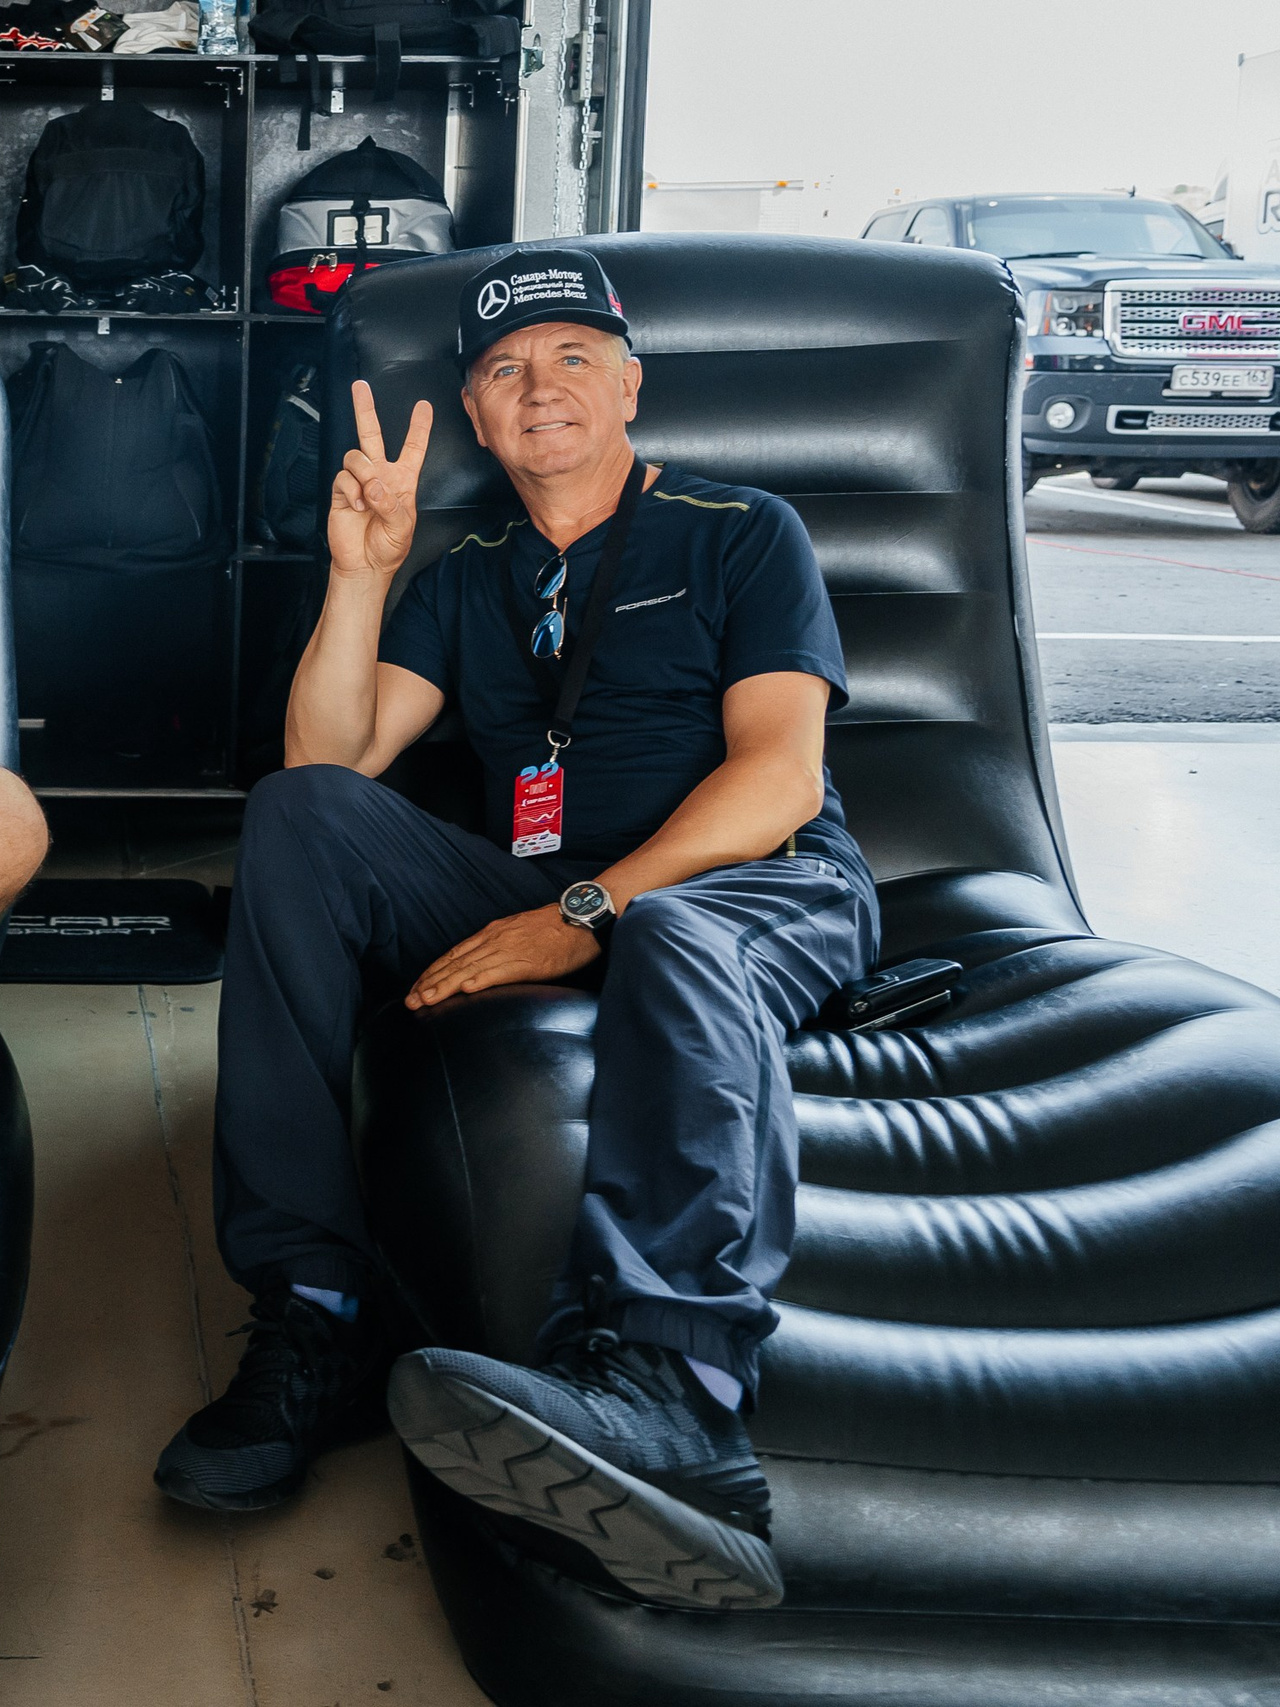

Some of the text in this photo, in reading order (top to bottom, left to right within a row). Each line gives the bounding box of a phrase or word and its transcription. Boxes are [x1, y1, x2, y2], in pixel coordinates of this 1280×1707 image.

[510, 268, 583, 286] Самара-Моторс
[513, 289, 588, 305] Mercedes-Benz
[1181, 313, 1261, 332] GMC
